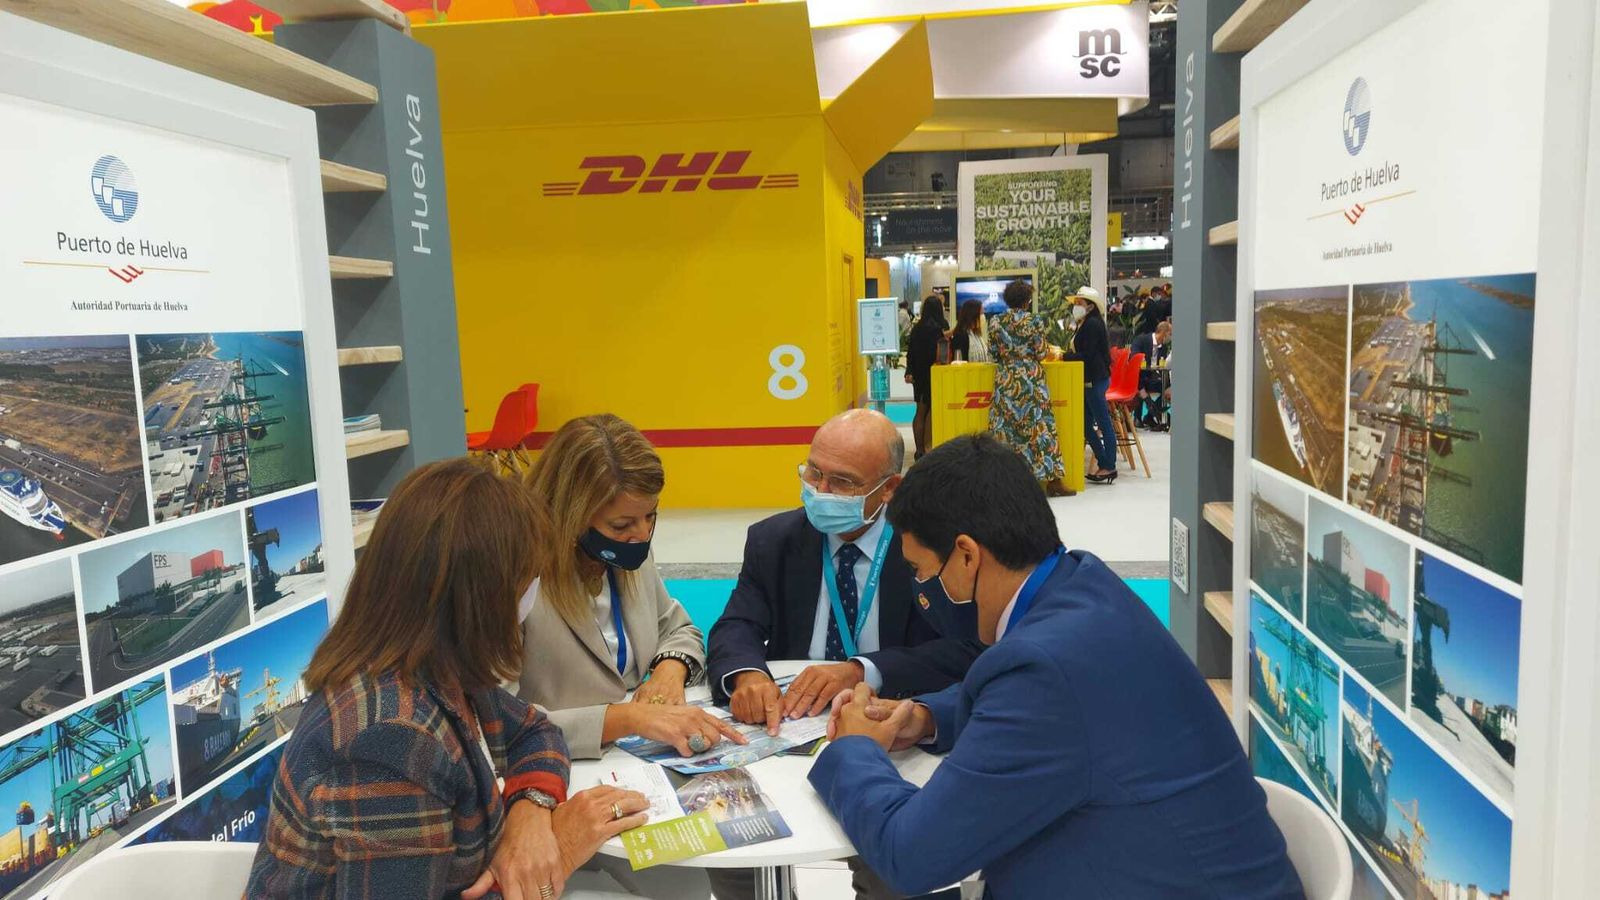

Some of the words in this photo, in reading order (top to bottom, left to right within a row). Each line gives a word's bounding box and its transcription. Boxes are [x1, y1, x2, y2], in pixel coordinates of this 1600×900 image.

[1181, 51, 1194, 229] Huelva
[406, 94, 431, 254] Huelva
[578, 150, 764, 195] DHL
[1008, 181, 1058, 189] SUPPORTING
[1322, 179, 1349, 201] Puerto
[1350, 170, 1362, 193] de
[1365, 161, 1400, 188] Huelva
[1009, 188, 1056, 203] YOUR
[976, 200, 1090, 219] SUSTAINABLE
[996, 216, 1070, 232] GROWTH
[57, 232, 112, 254] Puerto
[116, 236, 135, 256] de
[140, 239, 188, 260] Huelva
[1366, 244, 1373, 254] de
[1374, 241, 1392, 254] Huelva
[70, 300, 113, 311] Autoridad
[114, 301, 152, 311] Portuaria
[153, 302, 162, 311] de
[163, 302, 188, 312] Huelva
[768, 344, 808, 400] 8
[230, 810, 256, 837] Frío
